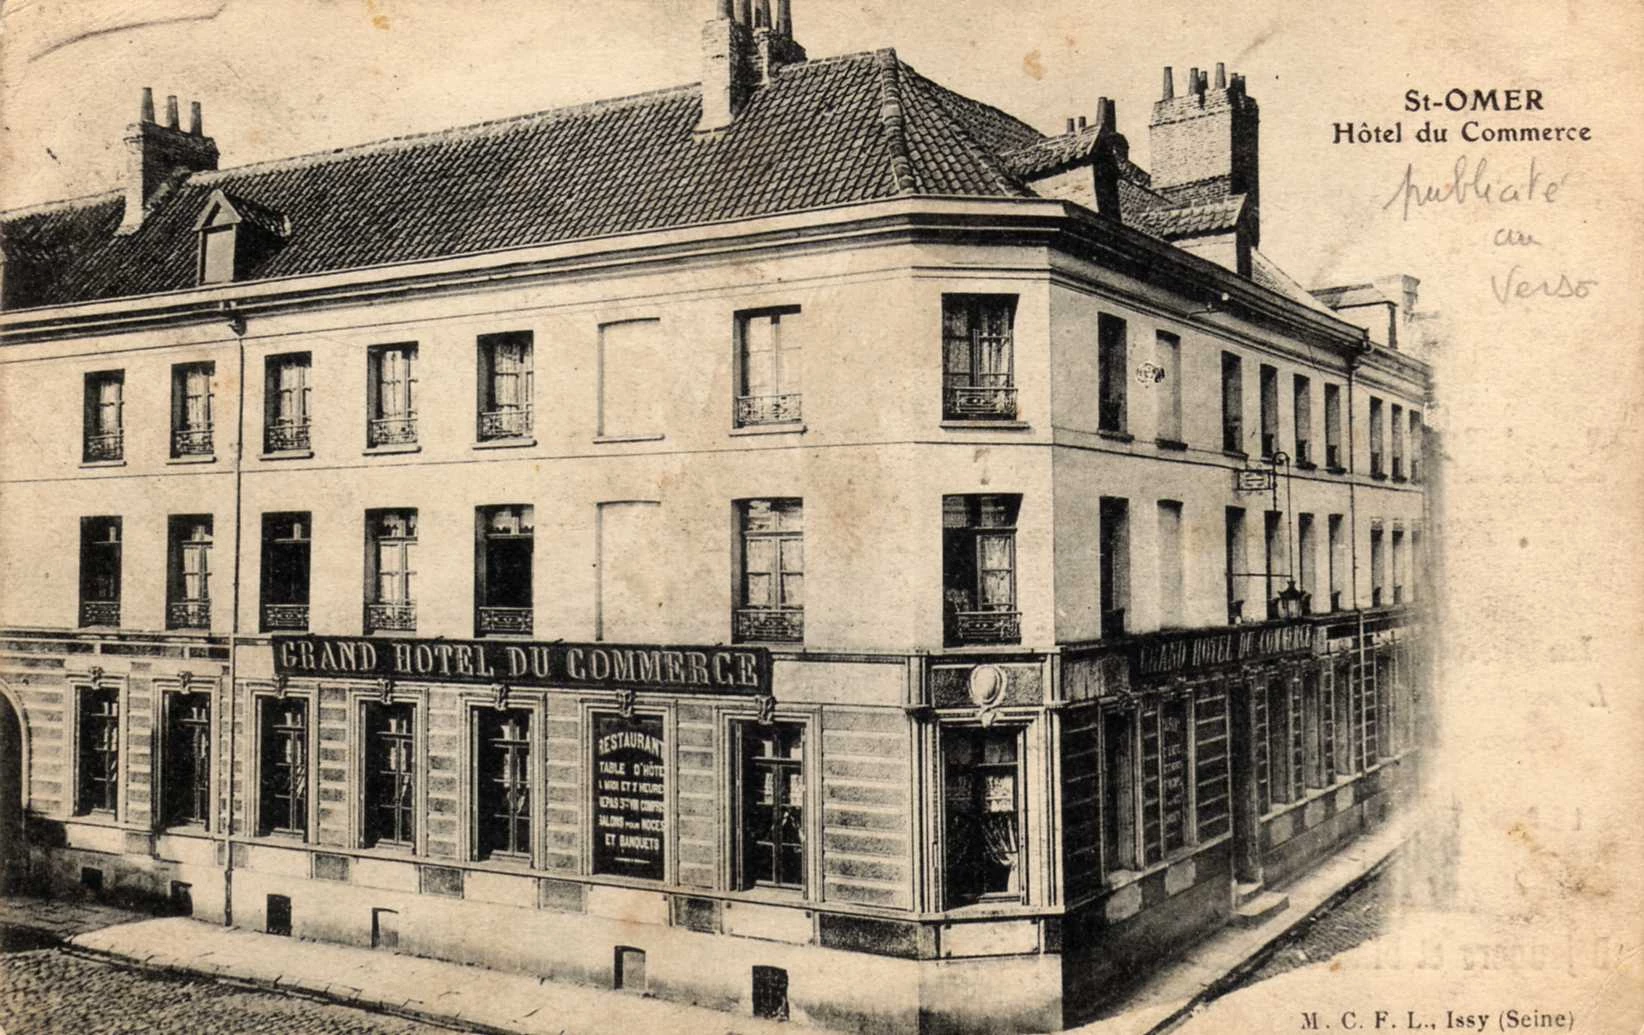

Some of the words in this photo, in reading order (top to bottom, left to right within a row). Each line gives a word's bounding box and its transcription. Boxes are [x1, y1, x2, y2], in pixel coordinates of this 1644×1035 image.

[281, 640, 377, 672] GRAND
[392, 642, 495, 677] HOTEL
[506, 645, 549, 678] DU
[566, 648, 759, 687] COMMERCE
[598, 731, 664, 760] RESTAURANT
[599, 761, 625, 776] TABLE
[605, 833, 616, 847] ET
